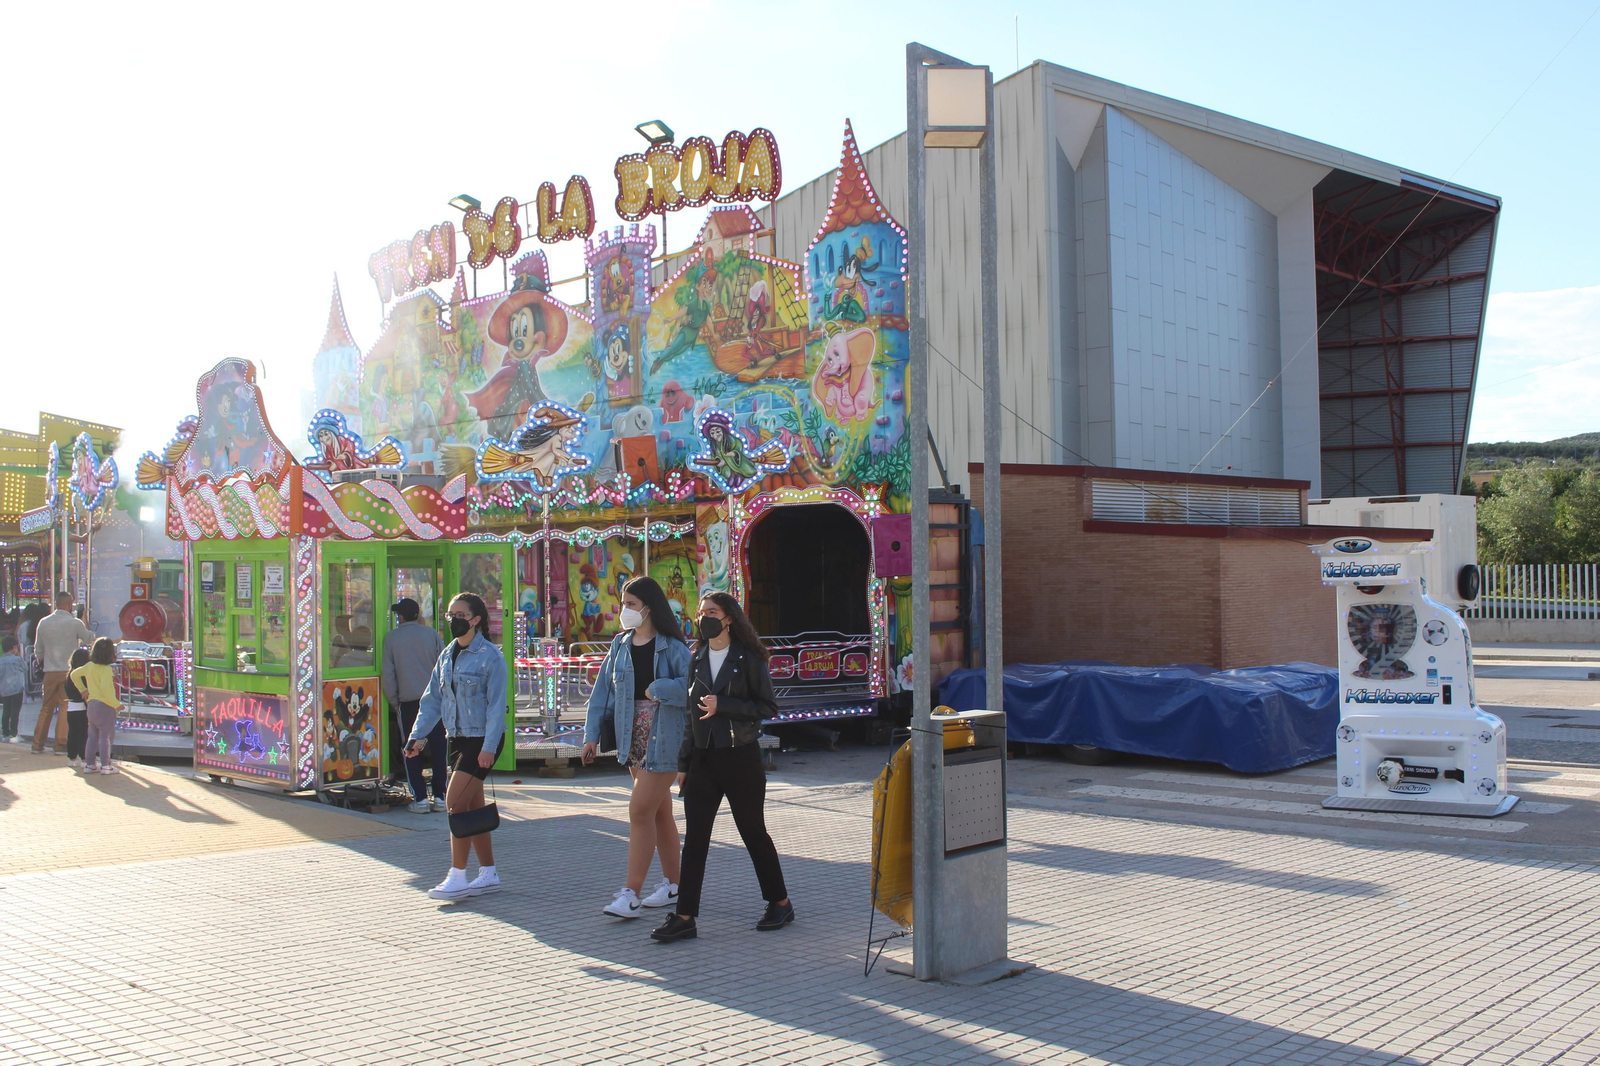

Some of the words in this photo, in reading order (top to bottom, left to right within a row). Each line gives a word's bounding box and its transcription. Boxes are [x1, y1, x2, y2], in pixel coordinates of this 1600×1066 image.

[370, 223, 454, 301] TREN
[464, 199, 518, 267] DE
[537, 178, 592, 241] LA
[615, 130, 778, 218] BRUJA
[1322, 562, 1401, 578] Kickboxer
[1345, 689, 1439, 704] Kickboxer
[211, 697, 284, 738] TAQUILLA
